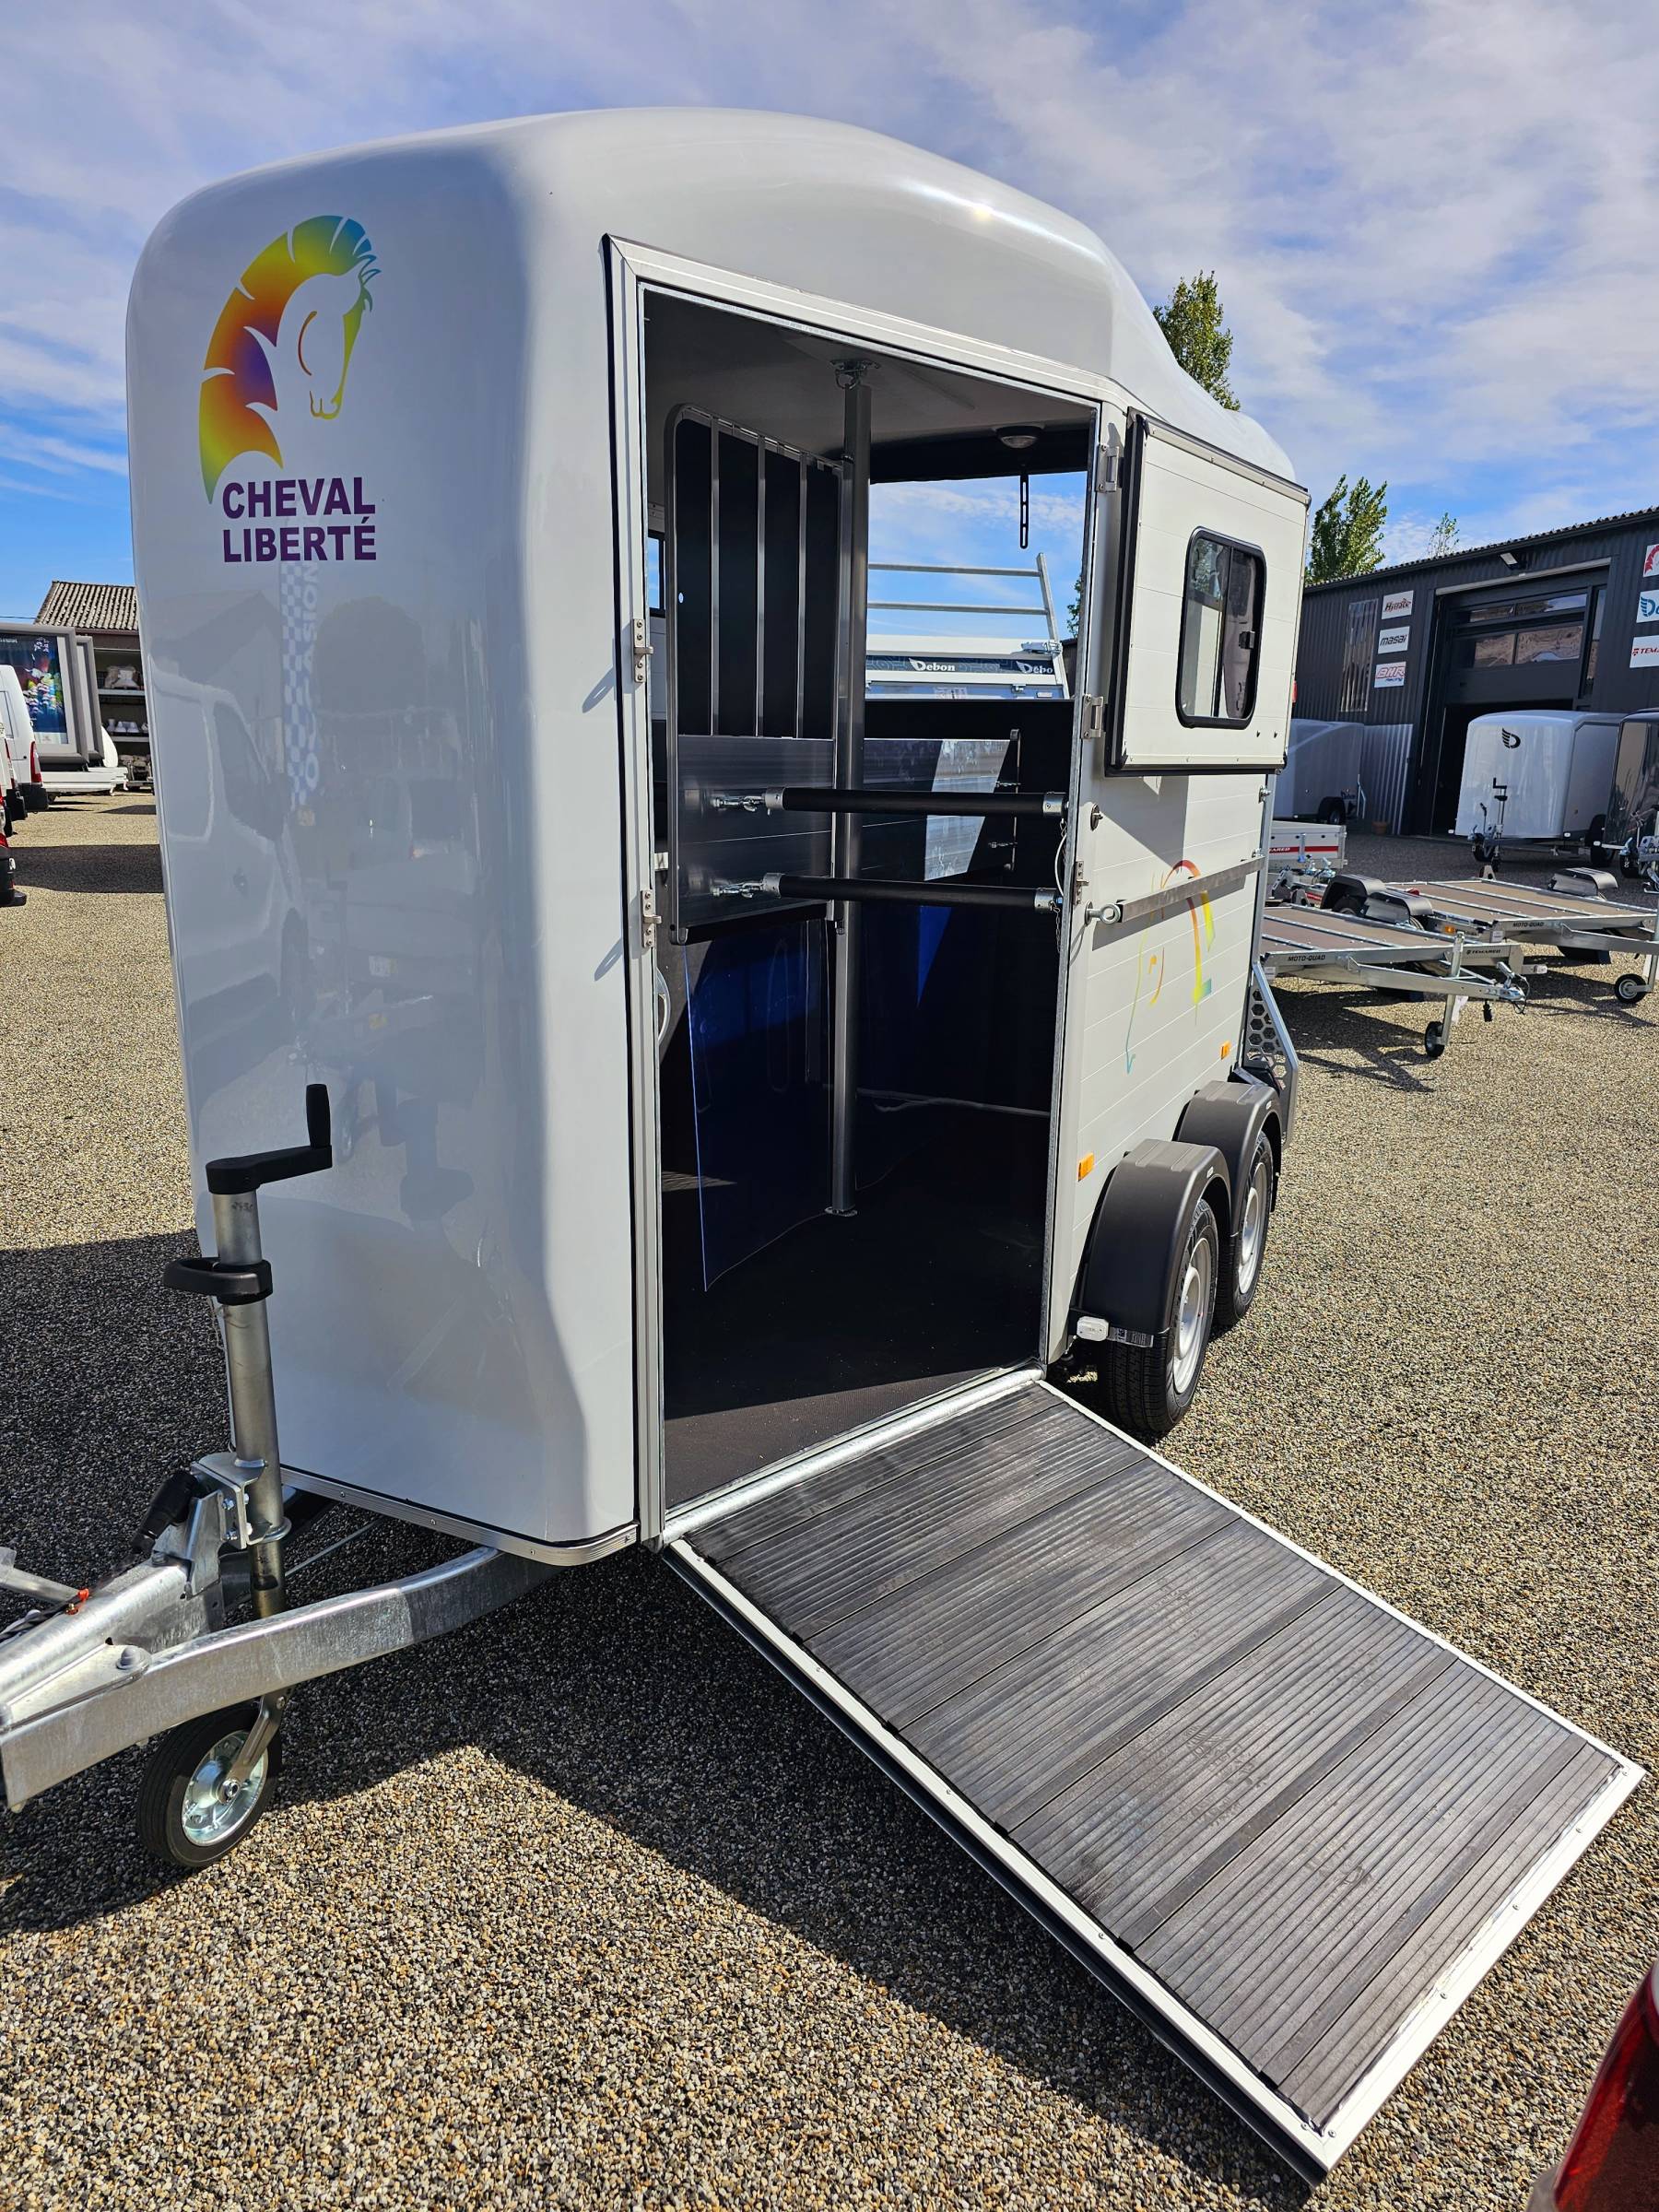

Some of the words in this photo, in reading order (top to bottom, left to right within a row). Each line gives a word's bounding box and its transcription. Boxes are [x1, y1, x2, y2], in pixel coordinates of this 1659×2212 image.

[222, 477, 376, 519] CHEVAL
[223, 516, 377, 562] LIBERTÉ
[1380, 634, 1407, 646] masai
[909, 657, 956, 672] Debon
[1016, 660, 1053, 674] Debo
